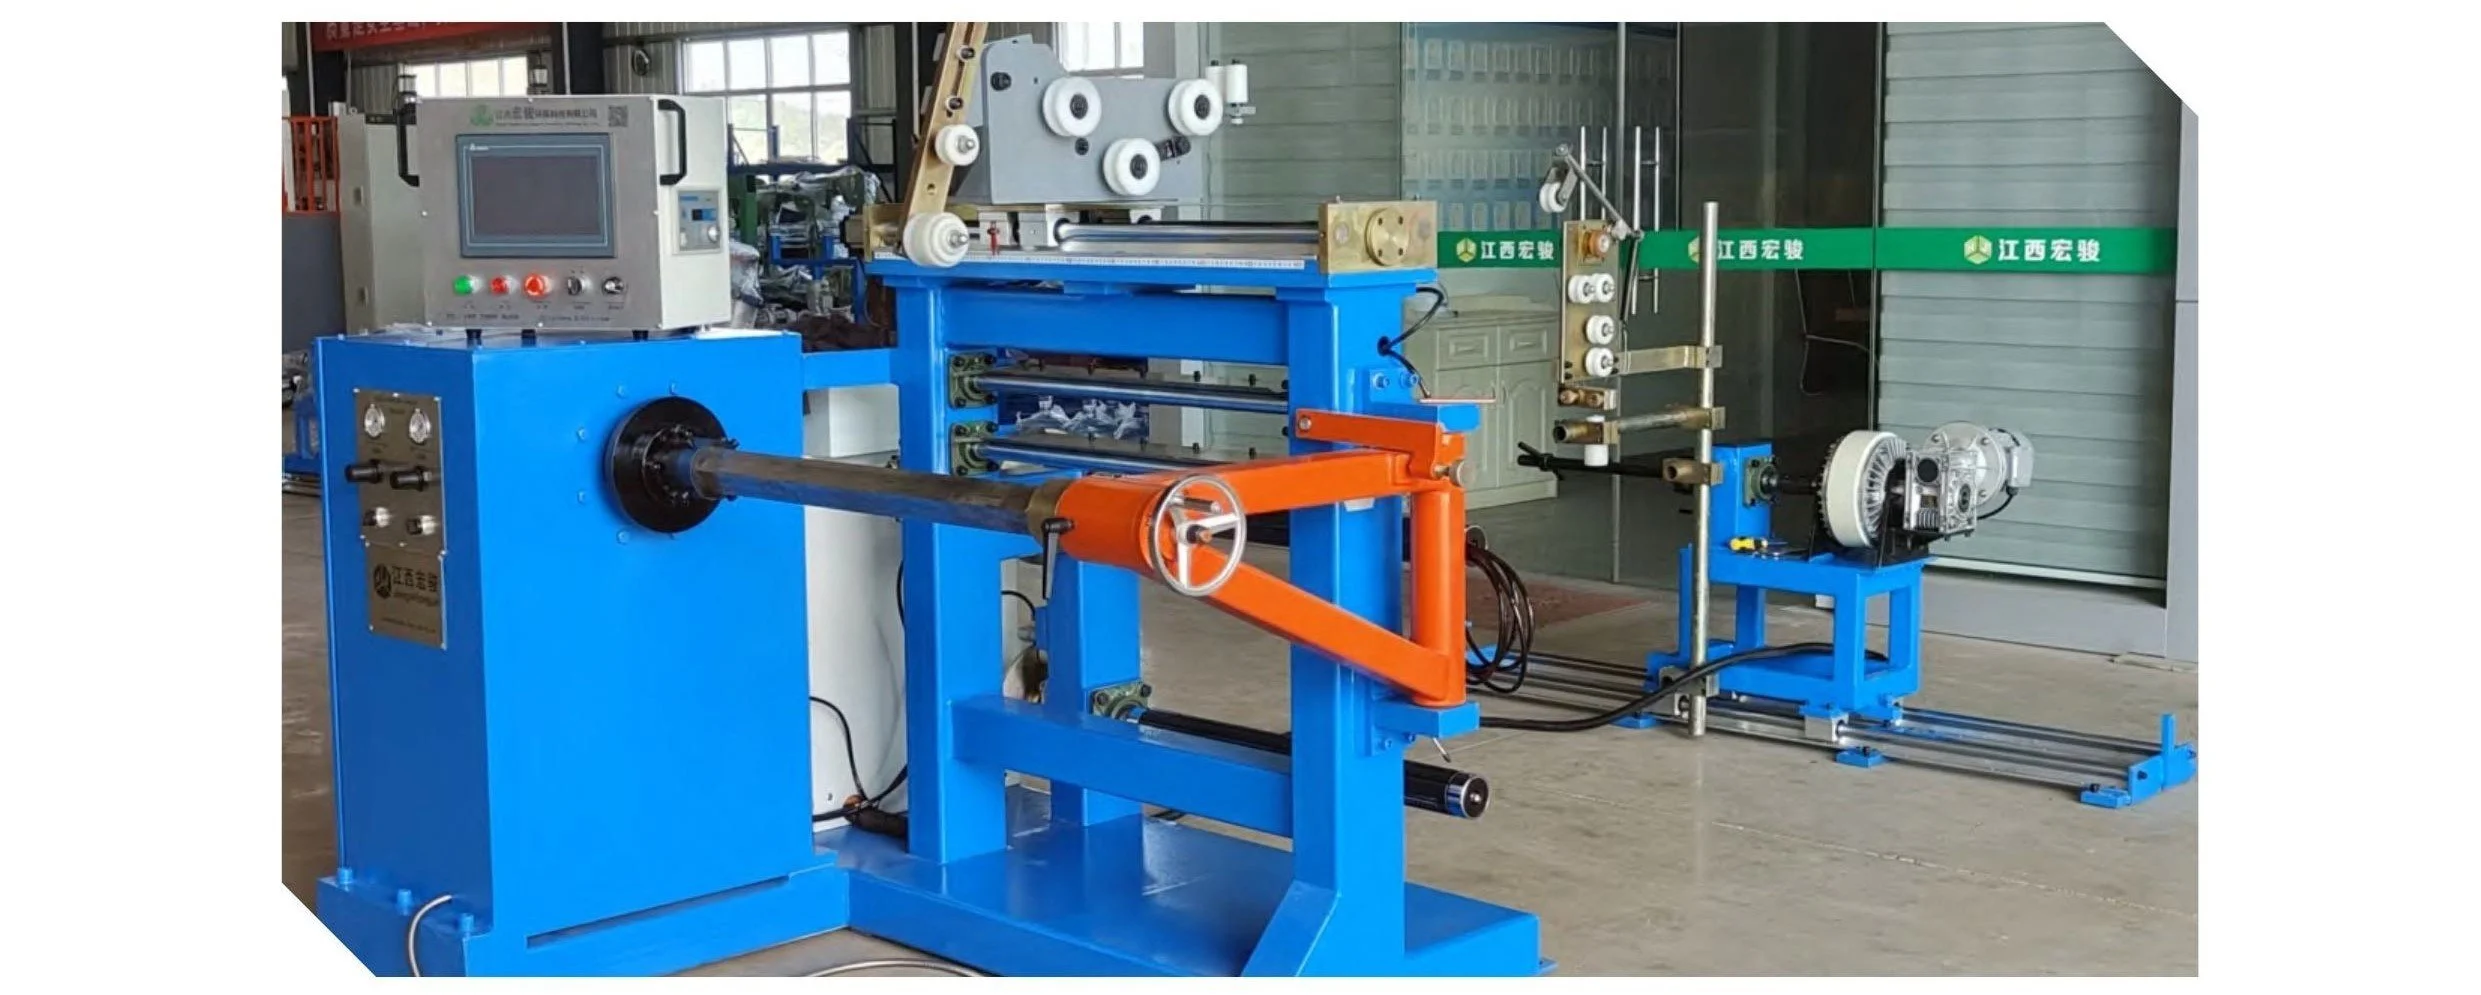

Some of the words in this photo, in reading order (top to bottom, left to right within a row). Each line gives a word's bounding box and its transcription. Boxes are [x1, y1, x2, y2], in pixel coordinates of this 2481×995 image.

[1481, 240, 1554, 260] 江西宏骏
[1717, 239, 1804, 260] 江西宏骏
[1998, 239, 2100, 262] 江西宏骏
